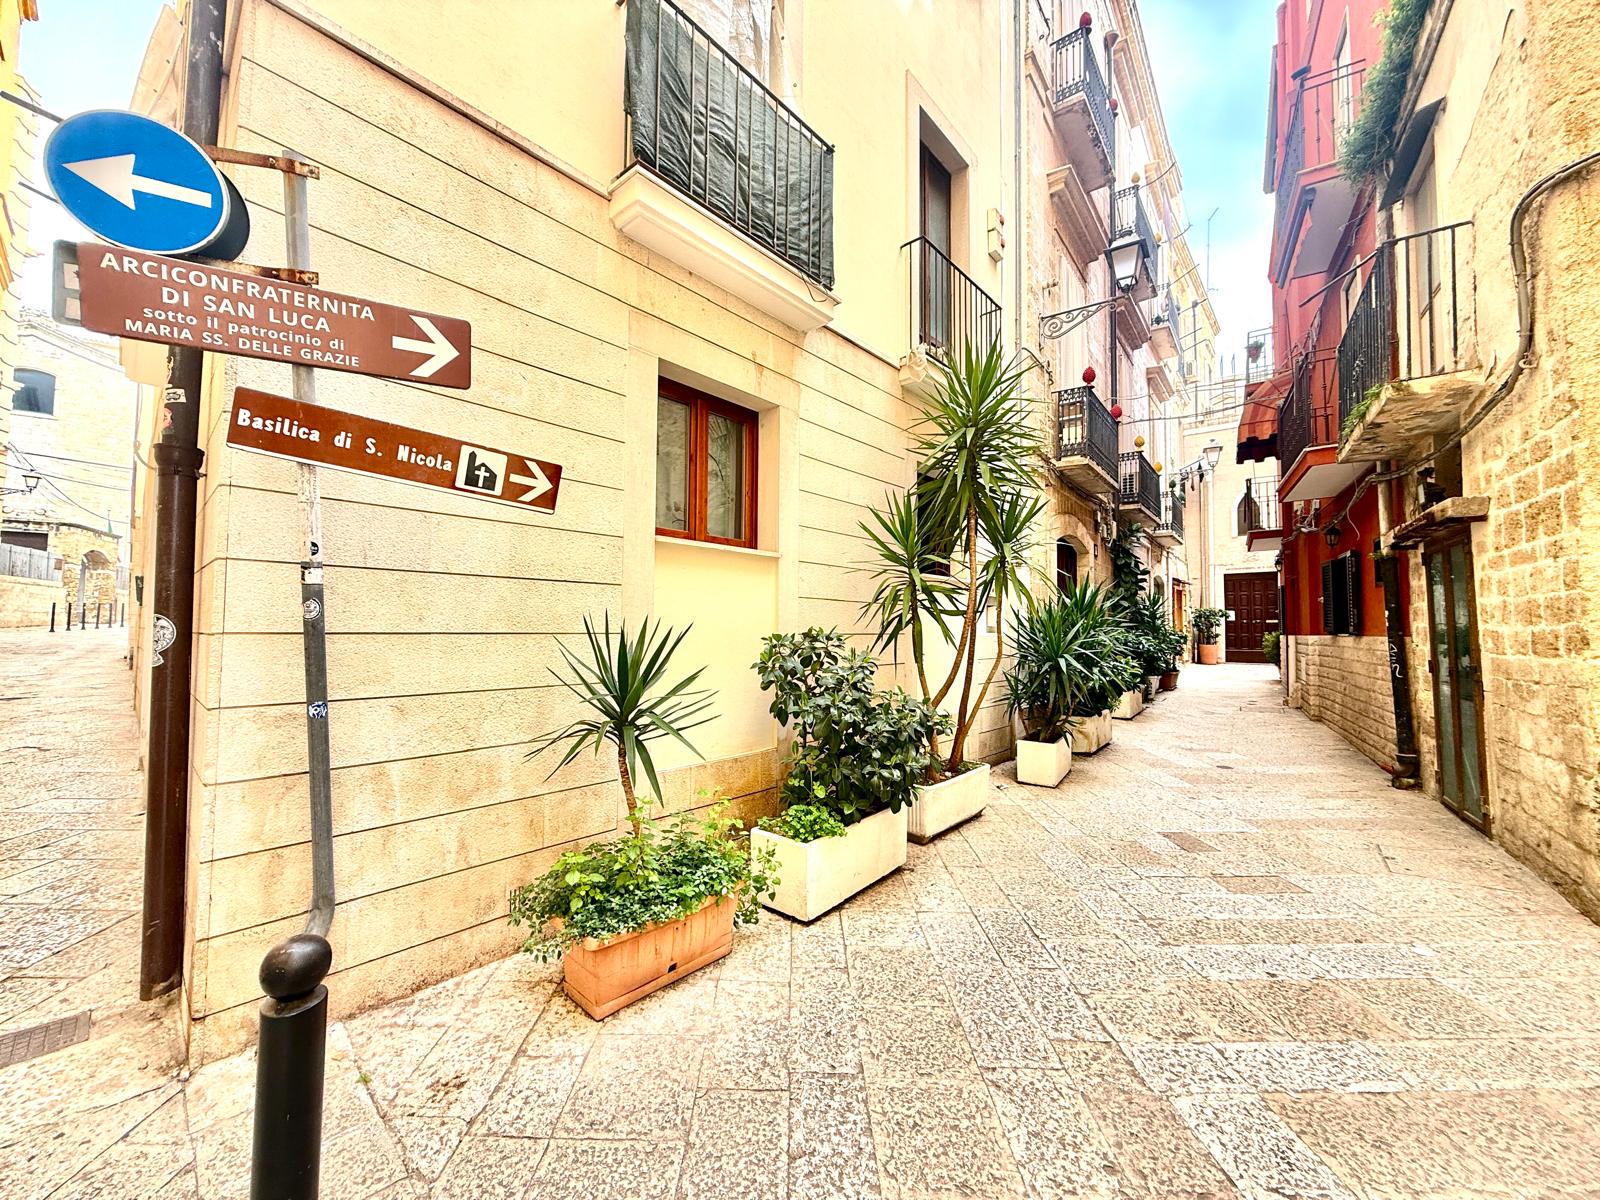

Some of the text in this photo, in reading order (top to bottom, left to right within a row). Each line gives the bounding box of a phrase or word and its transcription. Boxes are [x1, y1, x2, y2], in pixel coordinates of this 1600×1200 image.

[100, 253, 375, 321] ARCICONFRATERNITA
[162, 287, 330, 332] DI SAN LUCA
[125, 318, 360, 367] MARIA SS. DELLE GRAZIE
[143, 307, 344, 350] sotto il patrocinio di
[237, 408, 453, 472] Basilica di S. Nicola
